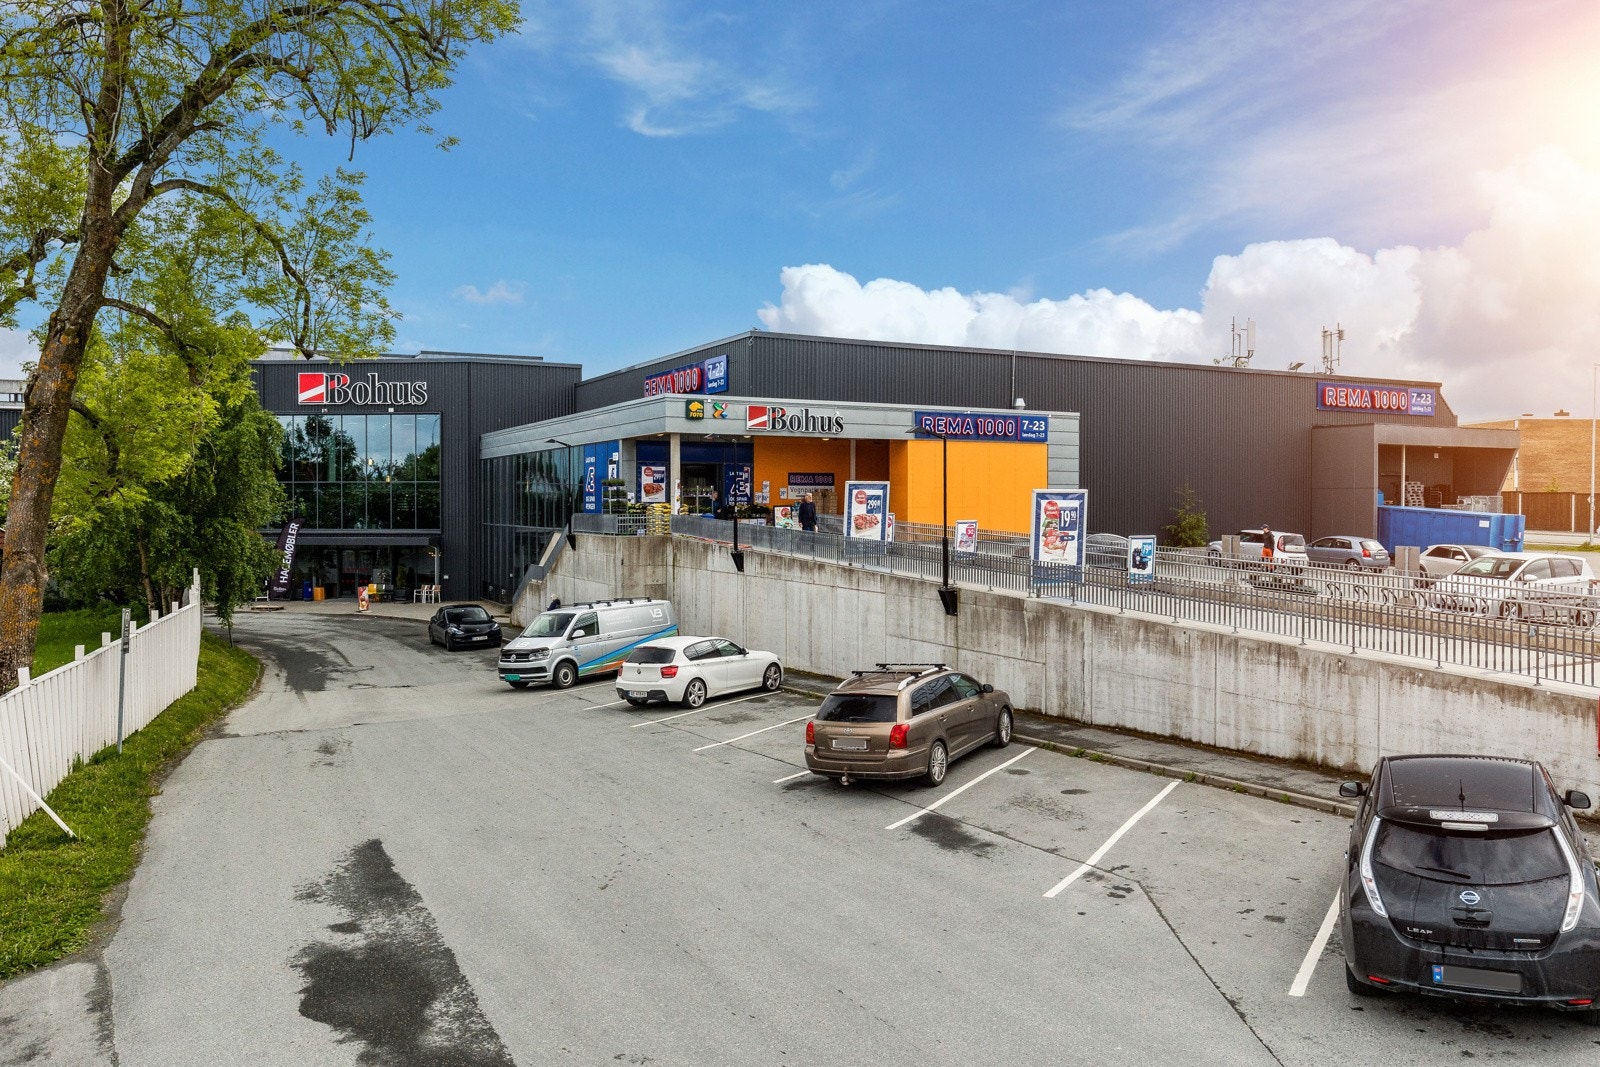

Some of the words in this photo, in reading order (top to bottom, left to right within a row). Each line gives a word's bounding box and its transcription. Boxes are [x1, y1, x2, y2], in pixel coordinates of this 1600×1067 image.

[707, 361, 725, 379] 7-23
[324, 372, 428, 406] Bohus
[644, 374, 673, 397] REMA
[674, 368, 698, 394] 1000
[1325, 387, 1371, 409] REMA
[1374, 390, 1408, 410] 1000
[1411, 392, 1432, 405] 7-23
[767, 406, 844, 434] Bohus
[922, 416, 974, 434] REMA
[977, 418, 1015, 436] 1000
[1022, 420, 1045, 431] 7-23
[1060, 510, 1070, 527] 19
